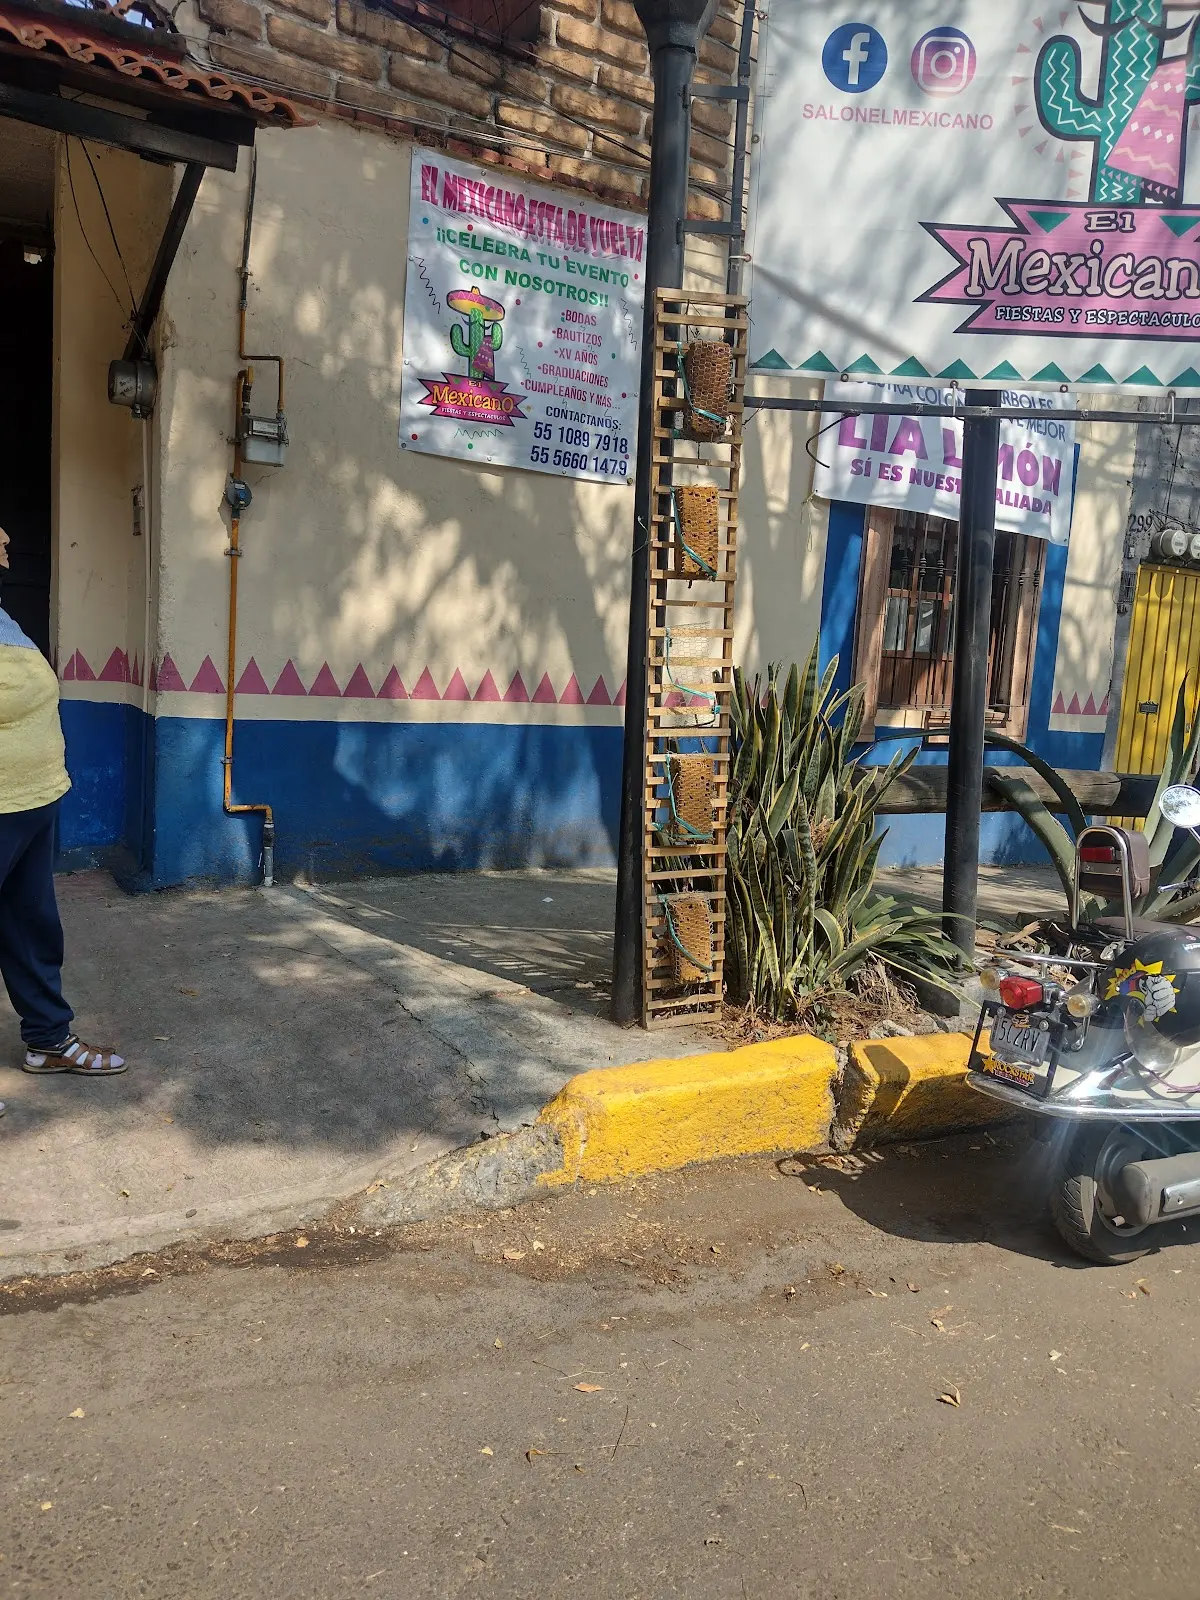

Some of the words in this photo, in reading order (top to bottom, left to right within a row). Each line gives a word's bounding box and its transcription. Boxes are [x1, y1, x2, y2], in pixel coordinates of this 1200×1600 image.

[802, 103, 994, 130] SALONELMEXICANO
[421, 164, 439, 206] EL
[443, 171, 526, 234] MEXICANO
[567, 209, 587, 249] DE
[590, 216, 644, 262] VUELTA
[1084, 211, 1136, 233] El
[459, 258, 498, 282] CON
[504, 269, 609, 308] NOSOTROS!!
[536, 252, 560, 270] TU
[566, 260, 629, 289] EVENTO
[996, 306, 1064, 323] FIESTAS
[1069, 308, 1082, 323] Y
[574, 349, 599, 366] AÑOS
[589, 392, 596, 405] Y
[545, 405, 623, 431] CONTACTANOS:
[1026, 418, 1066, 442] MEJOR
[533, 421, 553, 441] 55
[558, 426, 590, 448] 1089
[594, 433, 628, 454] 7918
[530, 445, 550, 464] 55
[552, 449, 588, 470] 5660
[592, 456, 628, 476] 1479
[838, 412, 929, 460] LIA
[942, 427, 1062, 497] LMÓN
[850, 457, 872, 478] SÍ
[878, 462, 904, 482] ES
[996, 488, 1052, 516] ALIADA
[1128, 513, 1153, 533] 299
[994, 1059, 1035, 1083] ROCKSTAR
